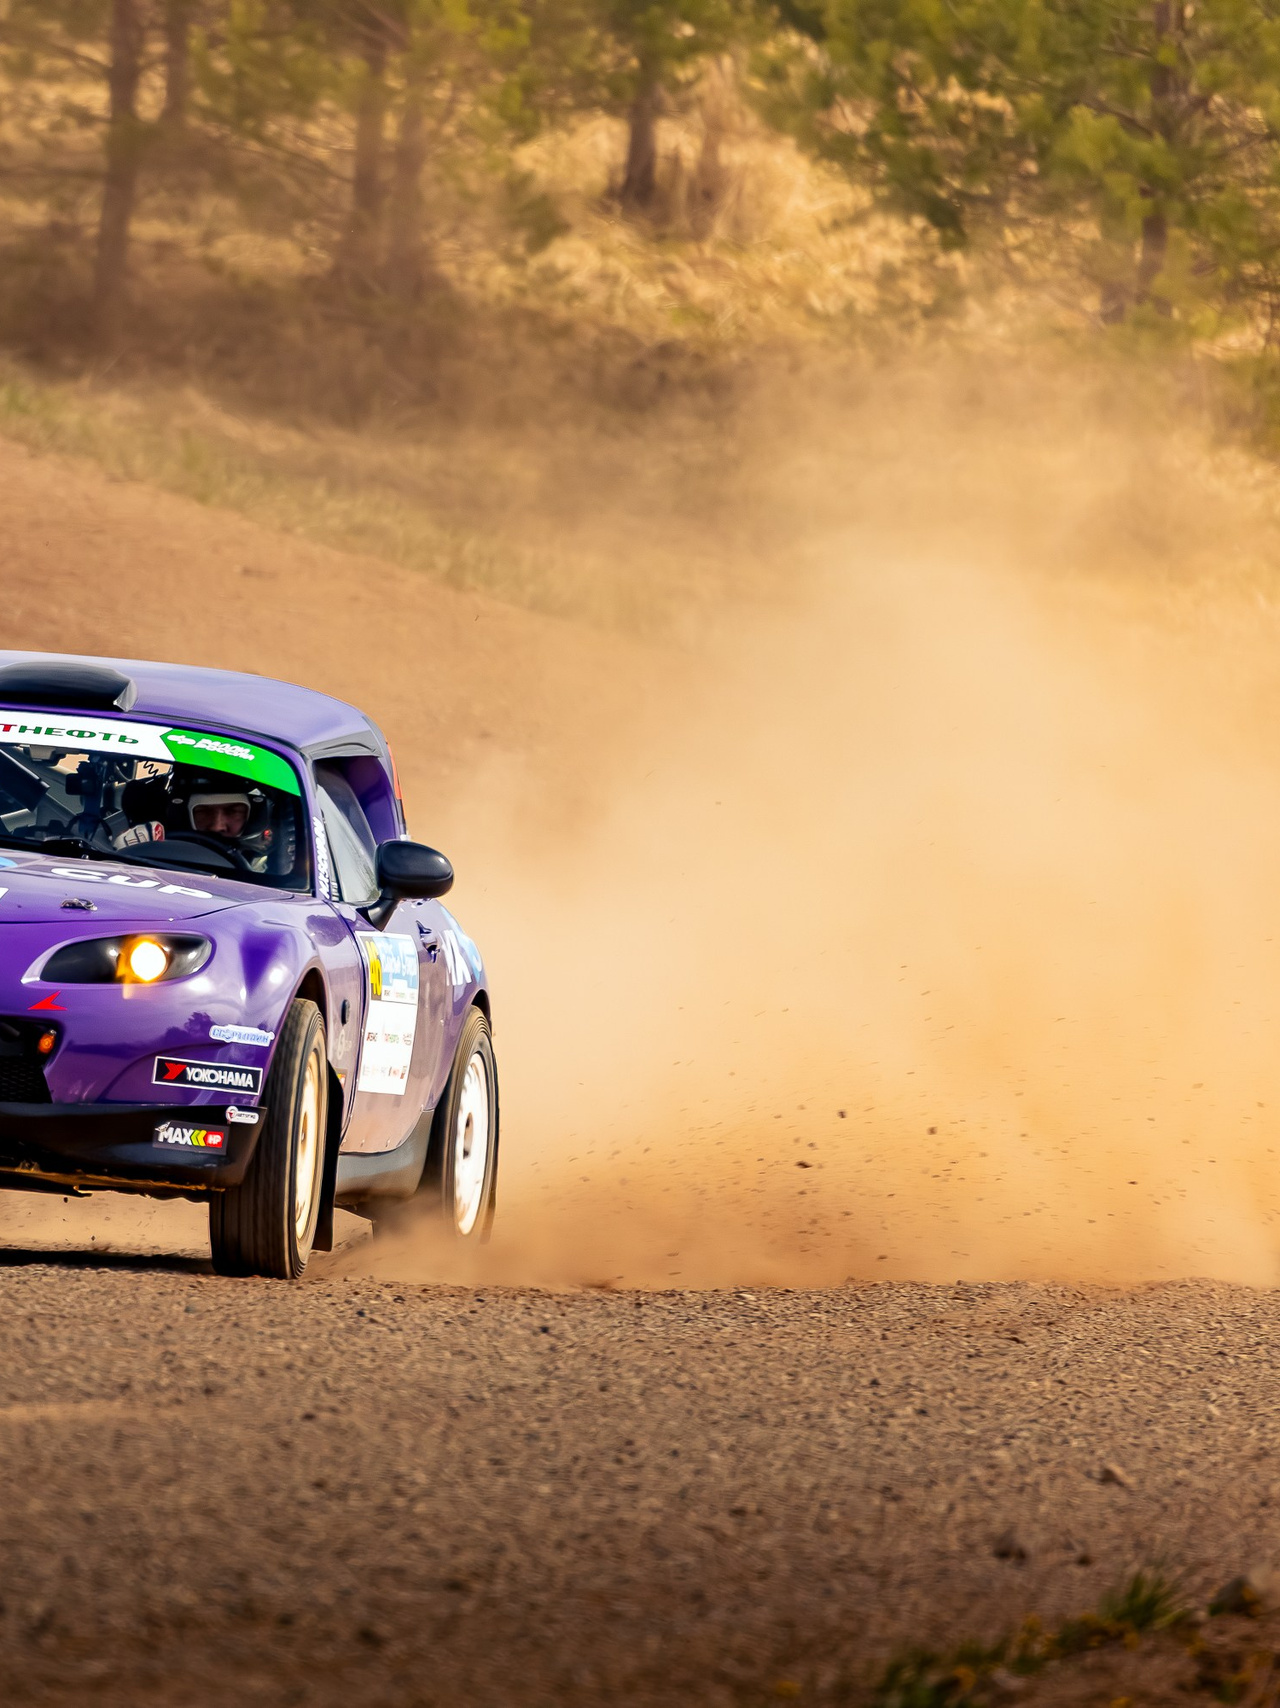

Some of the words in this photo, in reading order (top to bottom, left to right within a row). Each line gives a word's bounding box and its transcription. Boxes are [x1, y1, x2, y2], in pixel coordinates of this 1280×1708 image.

[51, 867, 213, 899] CUP
[185, 1066, 253, 1089] YOKOHAMA
[158, 1126, 194, 1146] MAX
[206, 1133, 223, 1145] HP
